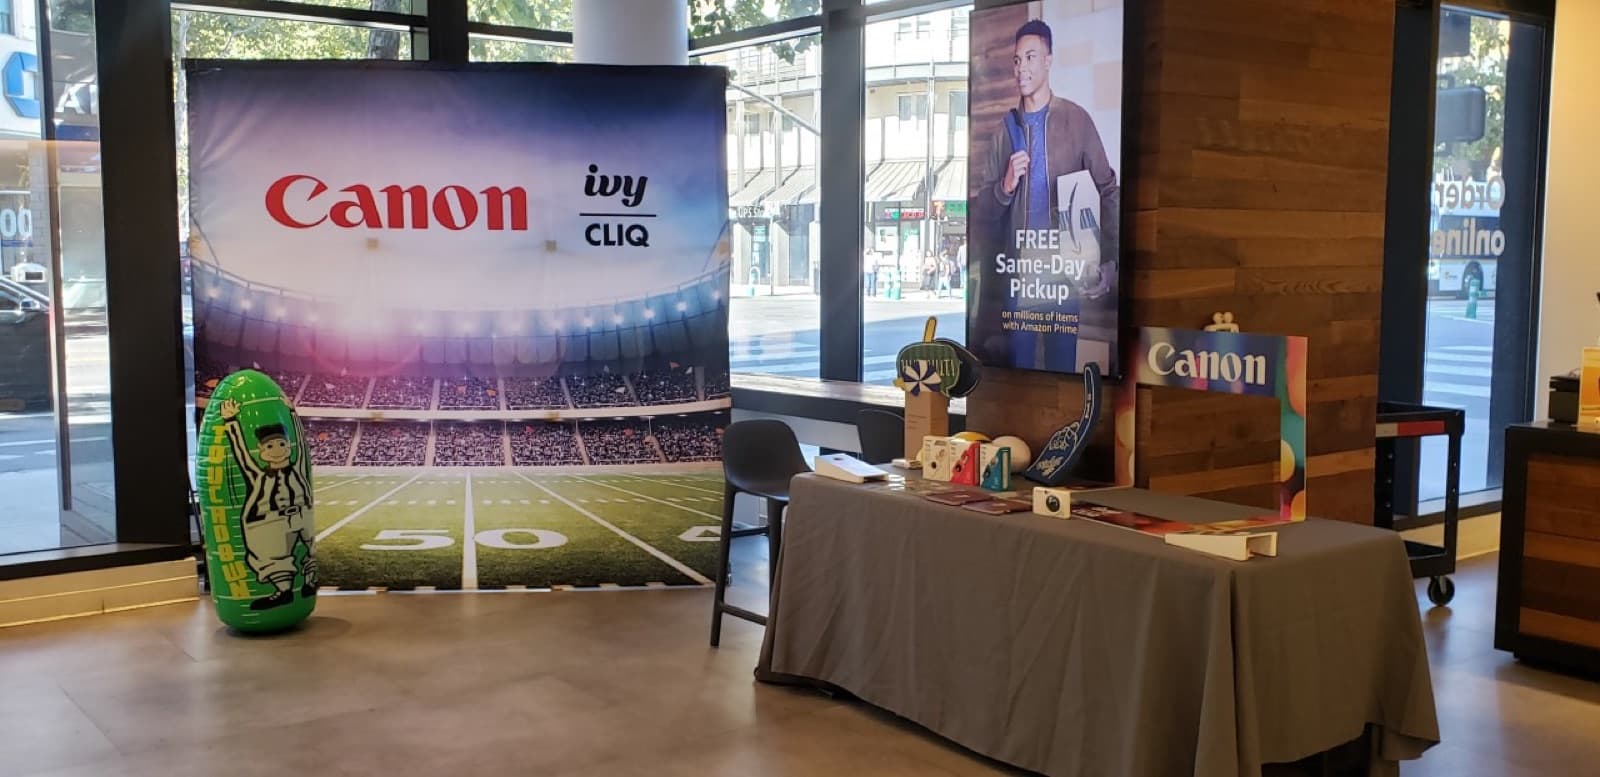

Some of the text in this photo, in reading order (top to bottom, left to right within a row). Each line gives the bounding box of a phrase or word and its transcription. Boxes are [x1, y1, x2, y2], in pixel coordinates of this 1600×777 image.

[584, 164, 649, 207] ivy
[265, 174, 528, 231] Canon
[585, 223, 650, 247] CLIQ
[1015, 229, 1060, 250] FREE
[995, 253, 1086, 280] Same-Day
[1010, 278, 1070, 305] Pickup
[1002, 310, 1079, 323] on millions of items
[1003, 321, 1080, 335] with Amazon Prime
[1147, 342, 1267, 386] Canon
